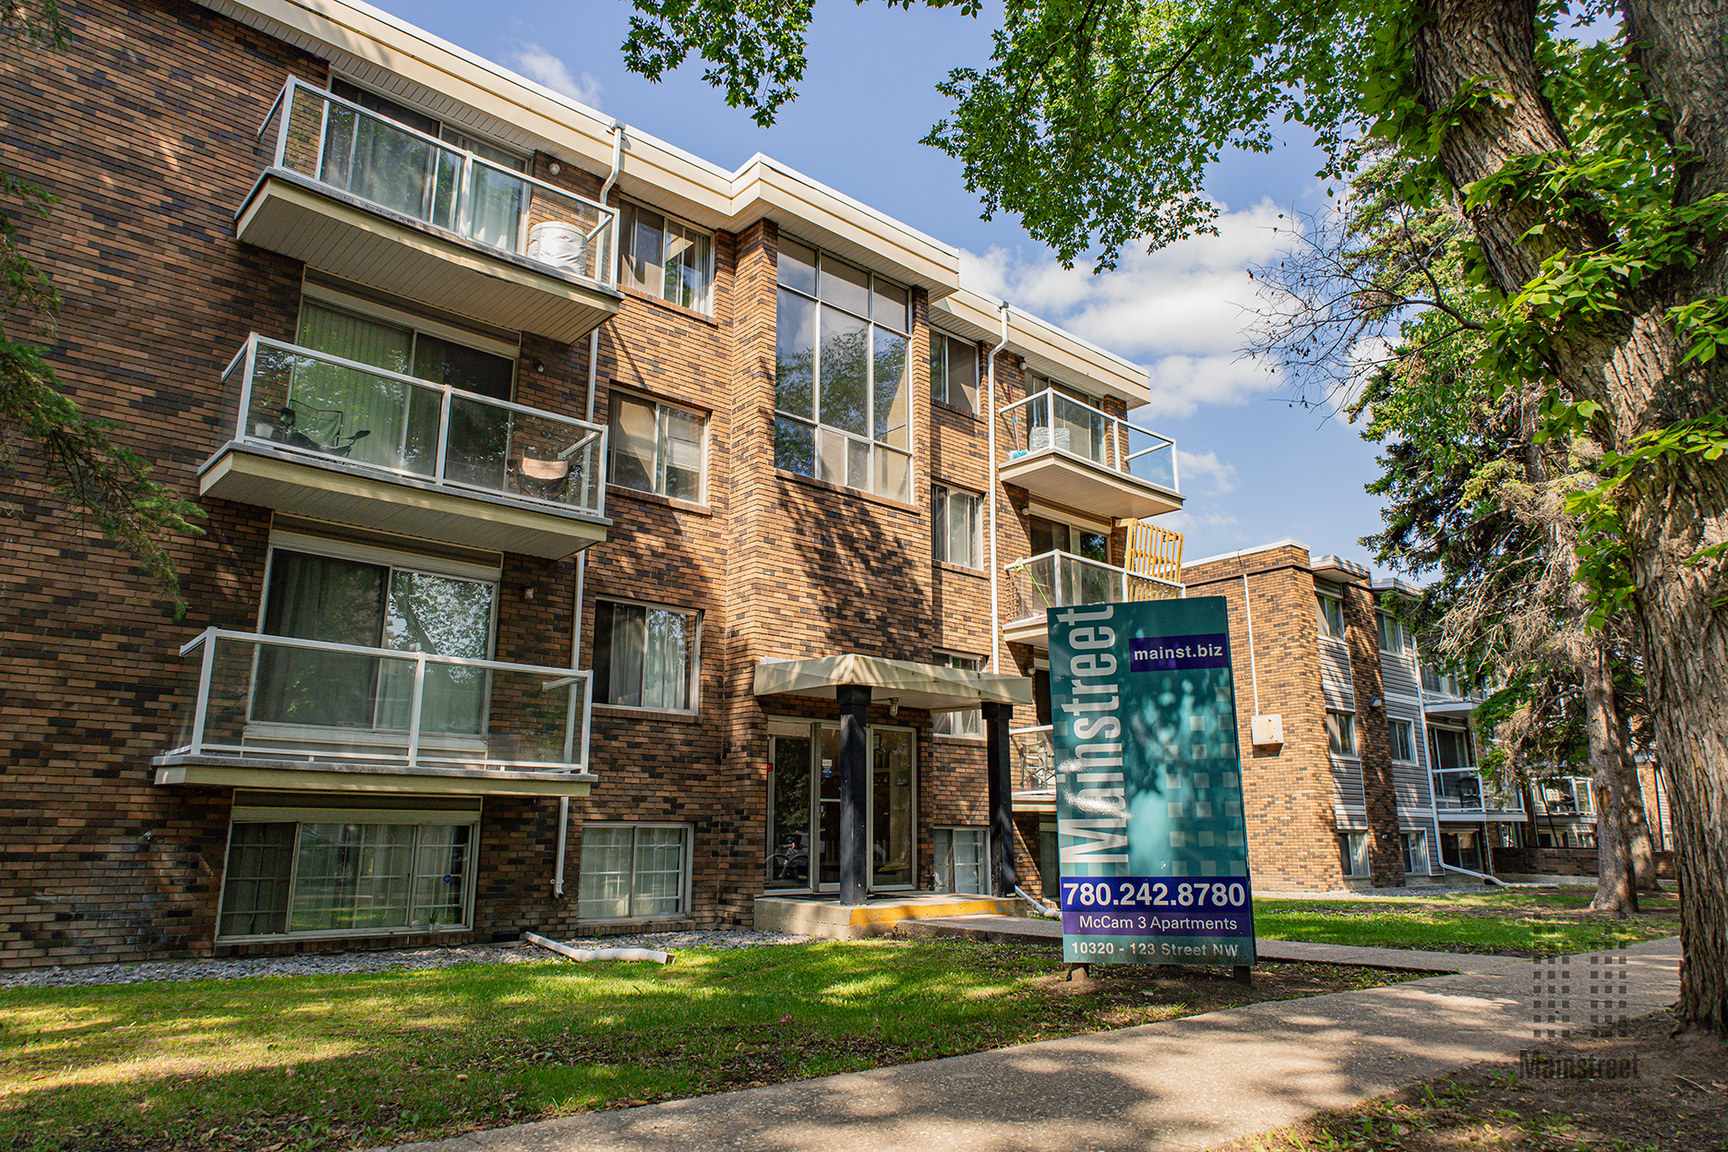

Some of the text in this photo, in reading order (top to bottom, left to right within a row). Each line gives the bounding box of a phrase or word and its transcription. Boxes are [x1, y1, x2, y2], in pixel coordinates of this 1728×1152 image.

[1134, 643, 1223, 661] mainst.biz
[1057, 605, 1129, 863] Mainstreet
[1063, 883, 1245, 906] 780.242.8780
[1079, 915, 1238, 932] McCam 3 Apartments
[1071, 941, 1115, 955] 10320
[1129, 942, 1156, 956] 123
[1160, 943, 1207, 957] Street
[1212, 944, 1239, 957] NW
